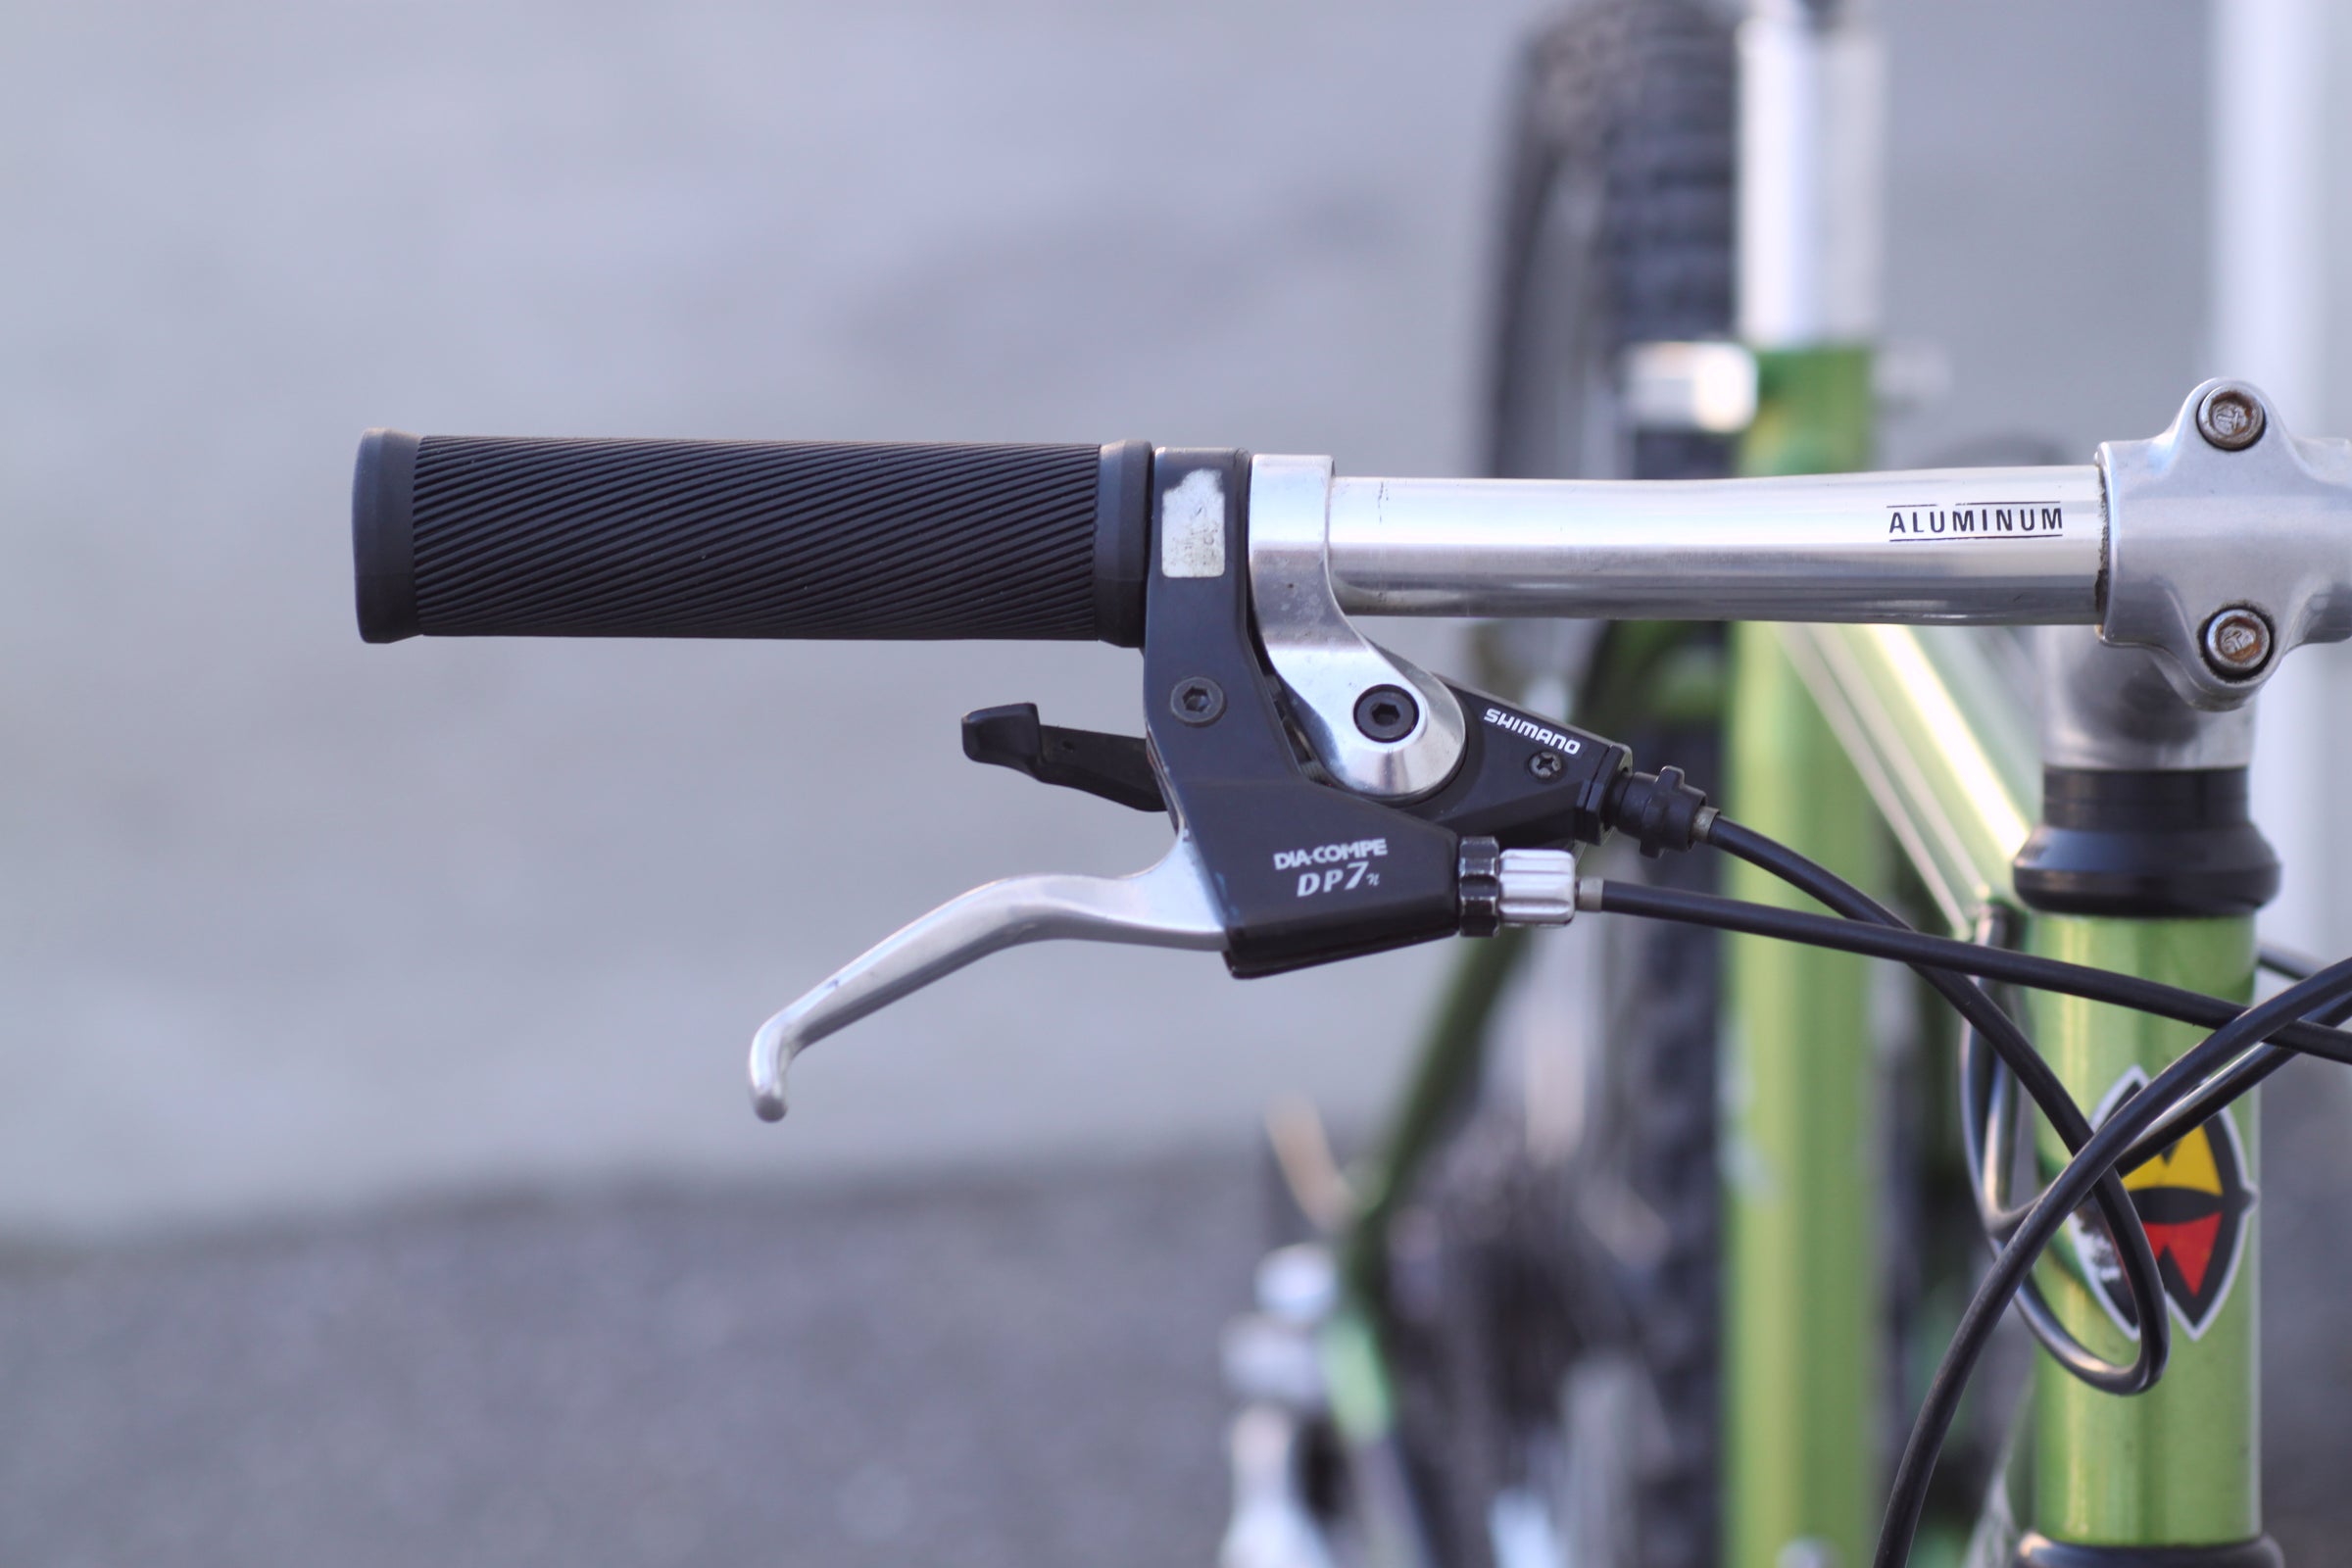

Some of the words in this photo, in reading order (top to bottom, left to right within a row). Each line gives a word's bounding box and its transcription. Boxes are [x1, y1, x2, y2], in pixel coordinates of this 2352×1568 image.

[1889, 508, 2063, 534] ALUMINUM
[1484, 708, 1581, 755] SHIMANO
[1274, 838, 1388, 870] DIA-COMPE
